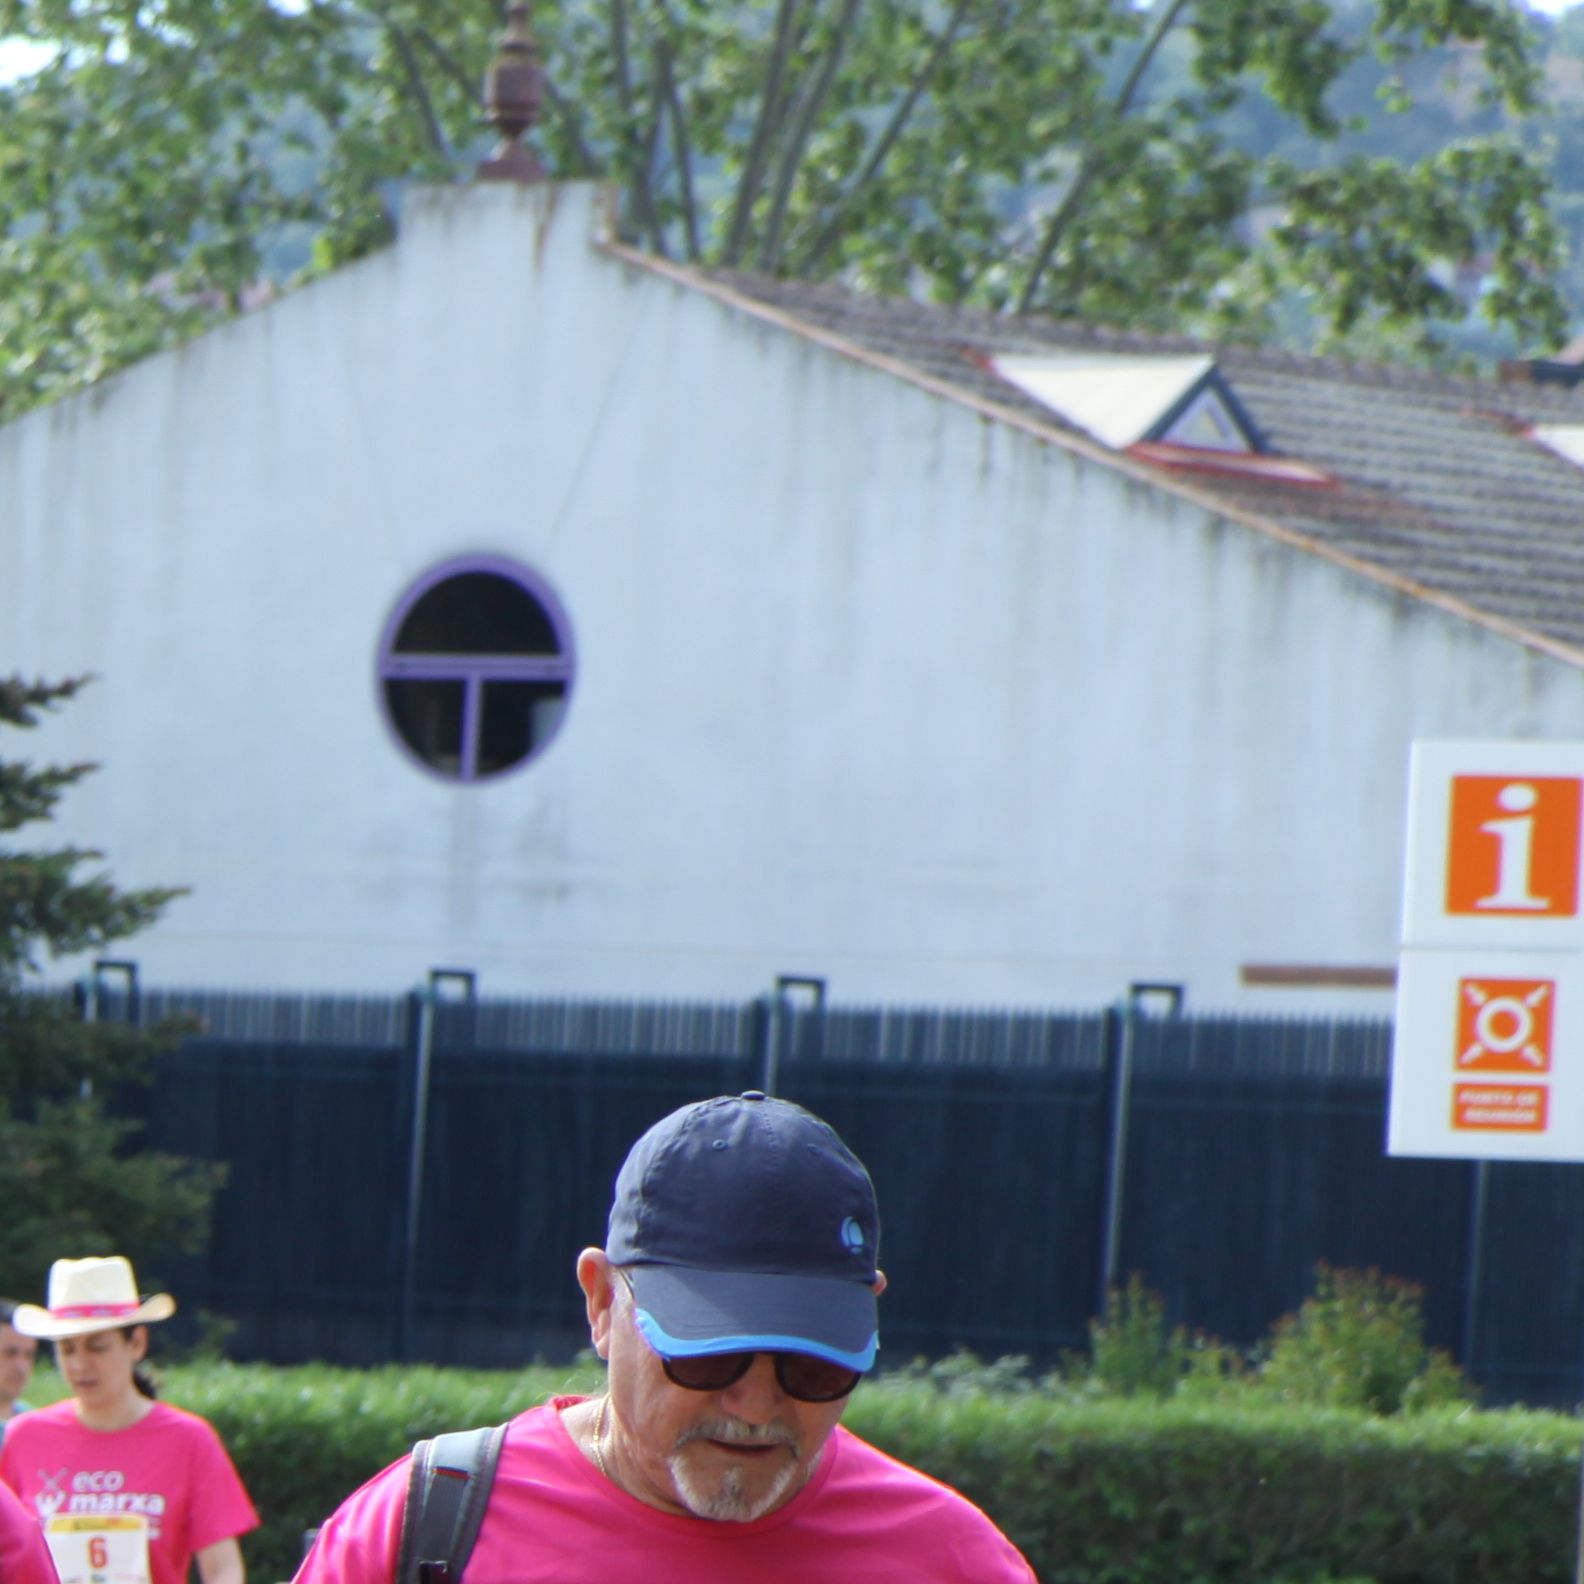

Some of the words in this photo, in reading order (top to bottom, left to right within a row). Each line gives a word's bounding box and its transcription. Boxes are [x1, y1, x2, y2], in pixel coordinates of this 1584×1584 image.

[72, 1470, 126, 1492] eco
[70, 1492, 166, 1516] marxa
[89, 1537, 108, 1569] 6
